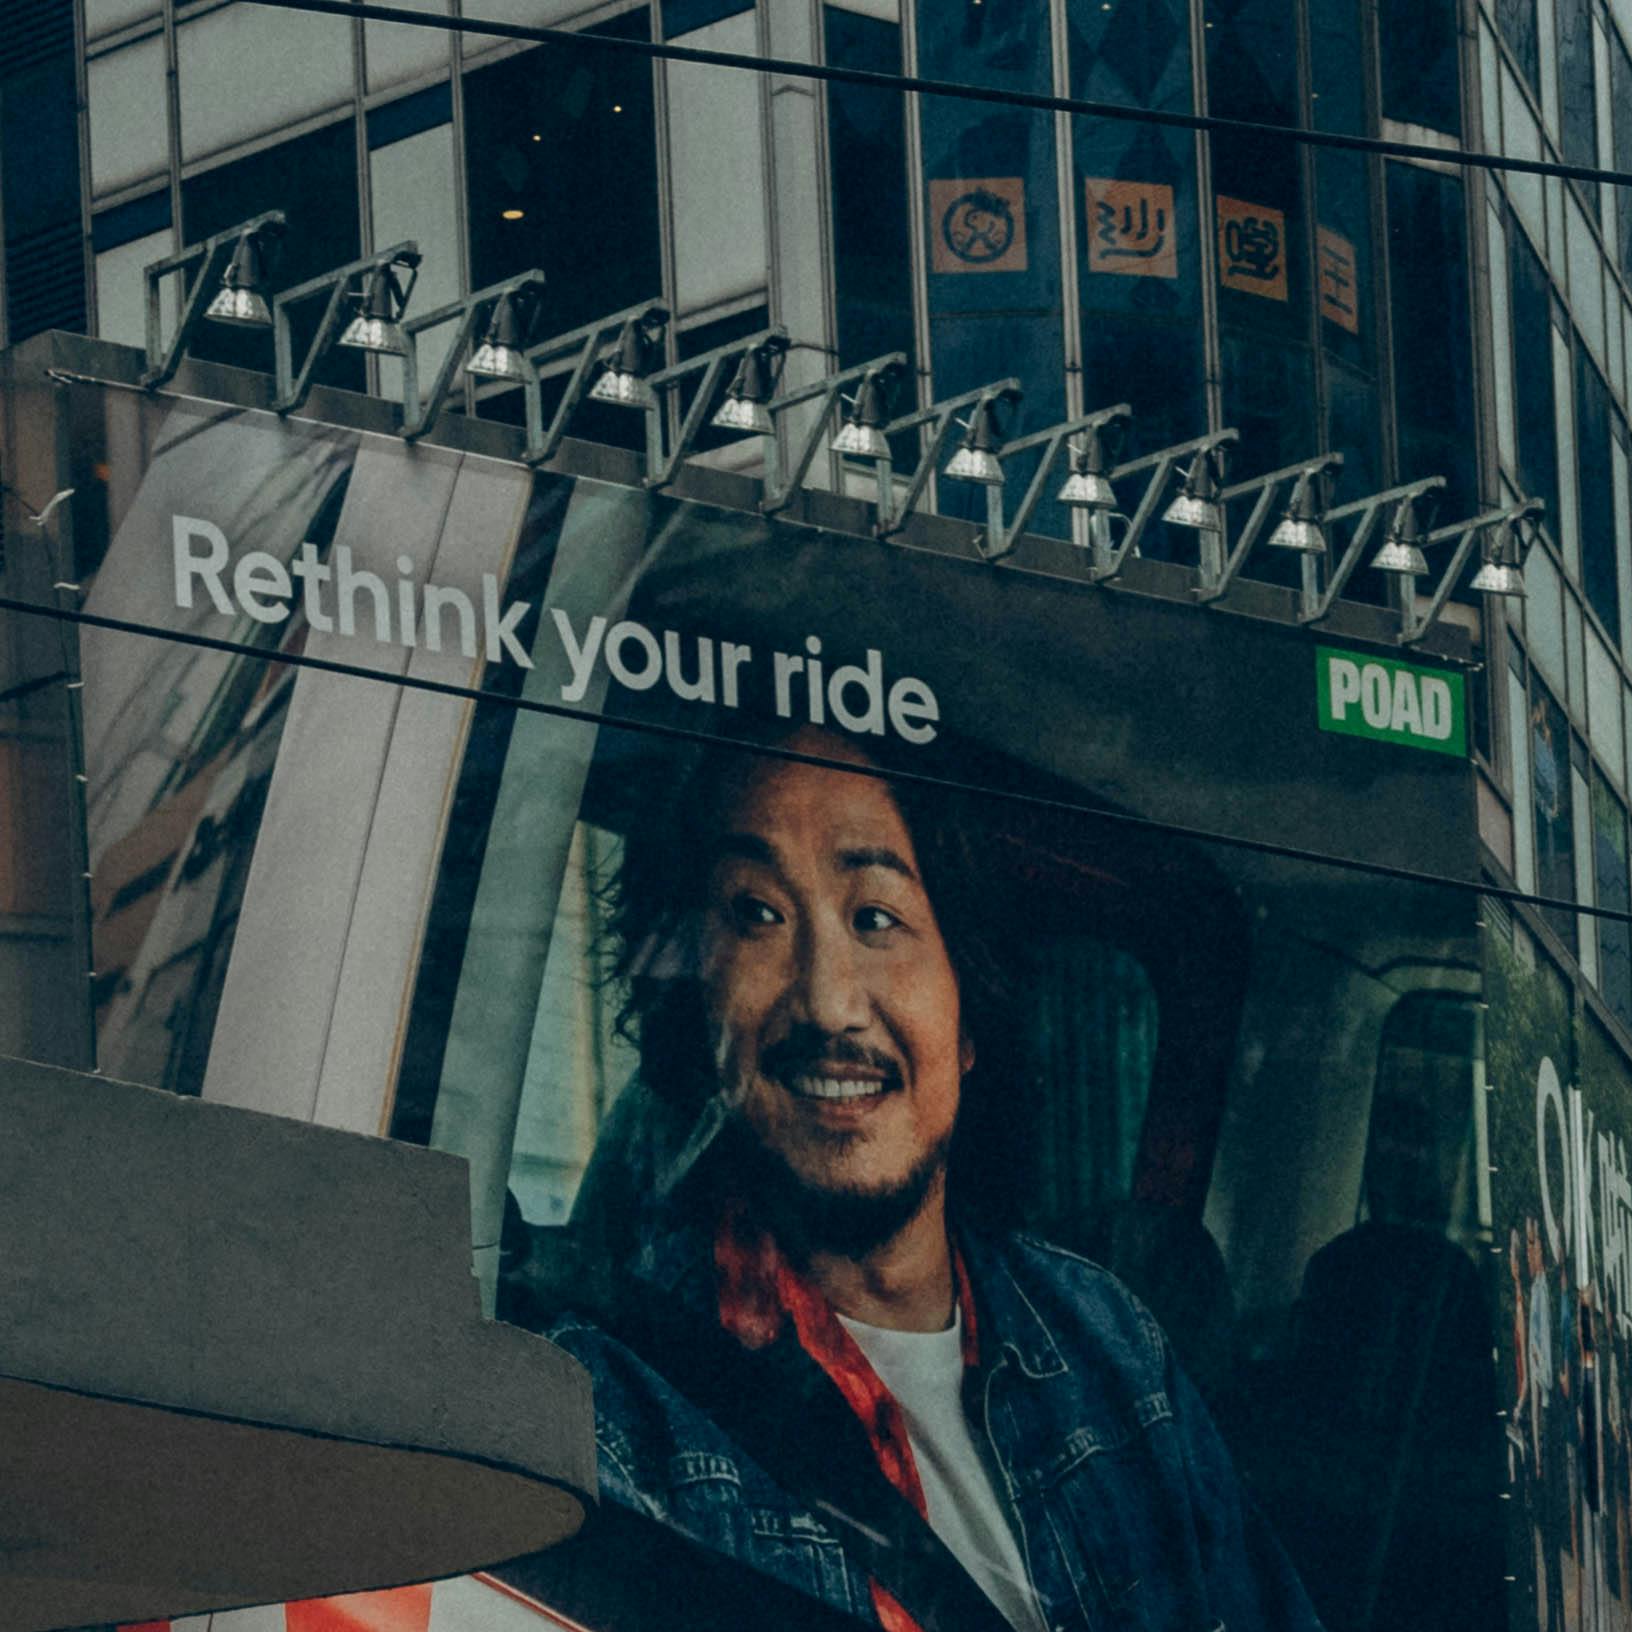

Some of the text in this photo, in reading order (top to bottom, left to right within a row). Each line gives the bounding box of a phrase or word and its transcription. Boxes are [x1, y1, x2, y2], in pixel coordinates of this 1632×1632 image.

[171, 513, 940, 744] Rethink your ride
[1329, 655, 1453, 742] POAD
